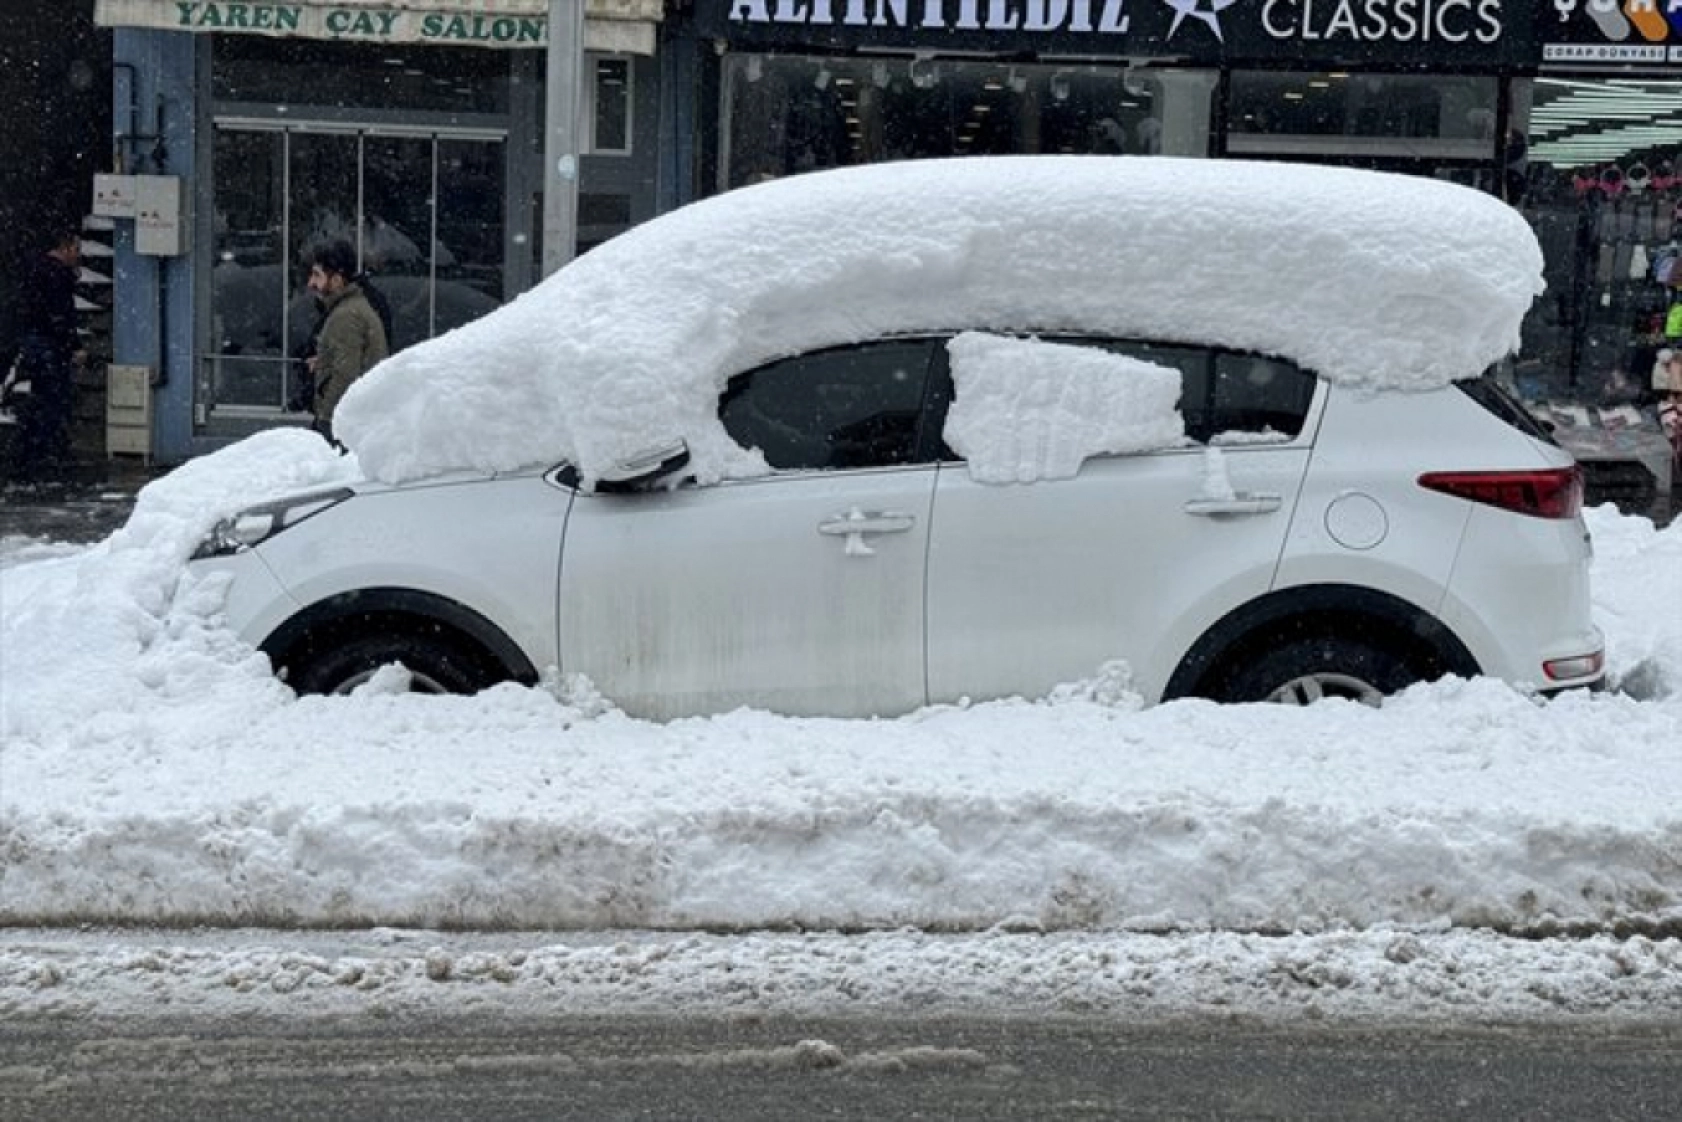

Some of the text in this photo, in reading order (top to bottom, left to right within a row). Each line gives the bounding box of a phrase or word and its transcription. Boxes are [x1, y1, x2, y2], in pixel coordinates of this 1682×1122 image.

[176, 1, 549, 42] YAREN ÇAY SALON
[1261, 0, 1503, 42] CLASSICS
